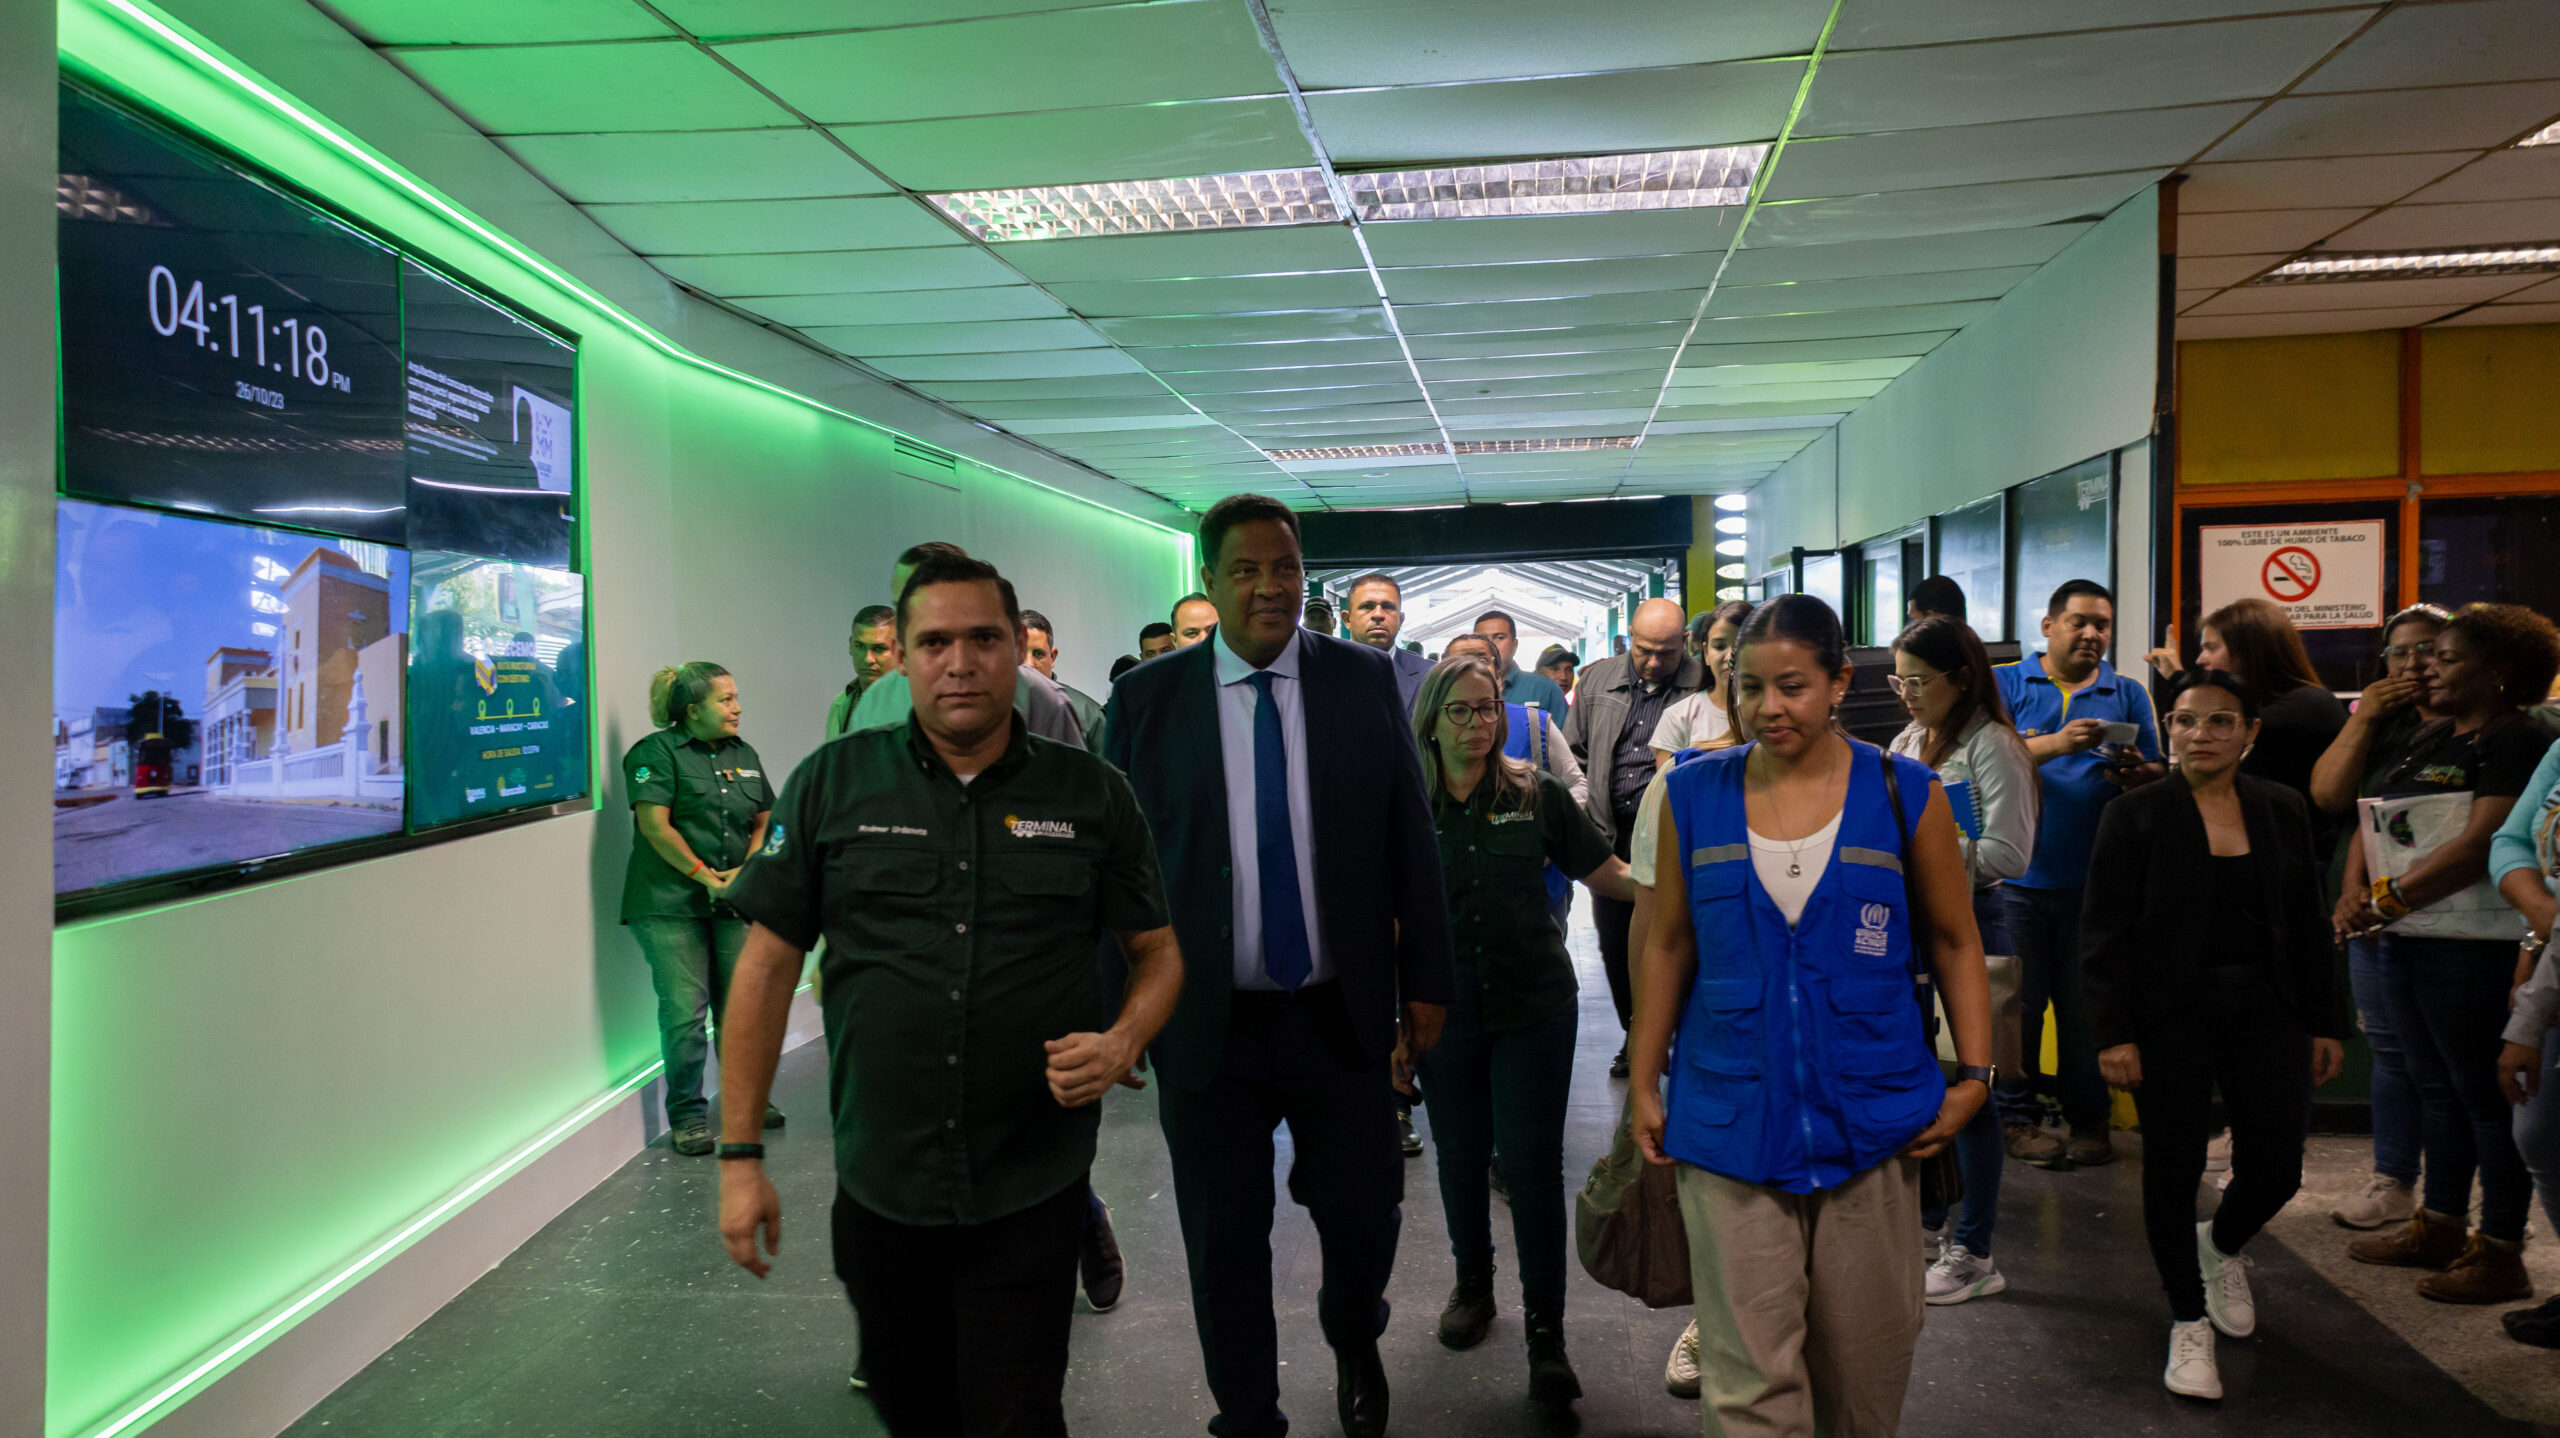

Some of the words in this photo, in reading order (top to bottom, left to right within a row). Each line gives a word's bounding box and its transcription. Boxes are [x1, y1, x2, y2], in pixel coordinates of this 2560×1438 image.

[149, 265, 329, 386] 04:11:18
[332, 371, 351, 393] PM
[235, 381, 284, 409] 26/10/23
[2077, 476, 2107, 498] TERMINA
[2241, 530, 2262, 538] ESTE
[2264, 530, 2275, 538] ES
[2276, 529, 2291, 537] UN
[2292, 528, 2339, 536] AMBIENTE
[2217, 539, 2241, 547] 100%
[2244, 538, 2268, 546] LIBRE
[2271, 537, 2281, 545] DE
[2284, 536, 2313, 544] HUMO
[2315, 535, 2326, 543] DE
[2330, 534, 2366, 543] TABACO
[2295, 605, 2311, 613] DEL
[2313, 604, 2366, 612] MINISTERIO
[2304, 612, 2327, 620] PARA
[2343, 610, 2373, 619] SALUD
[1010, 820, 1075, 833] TERMINAL
